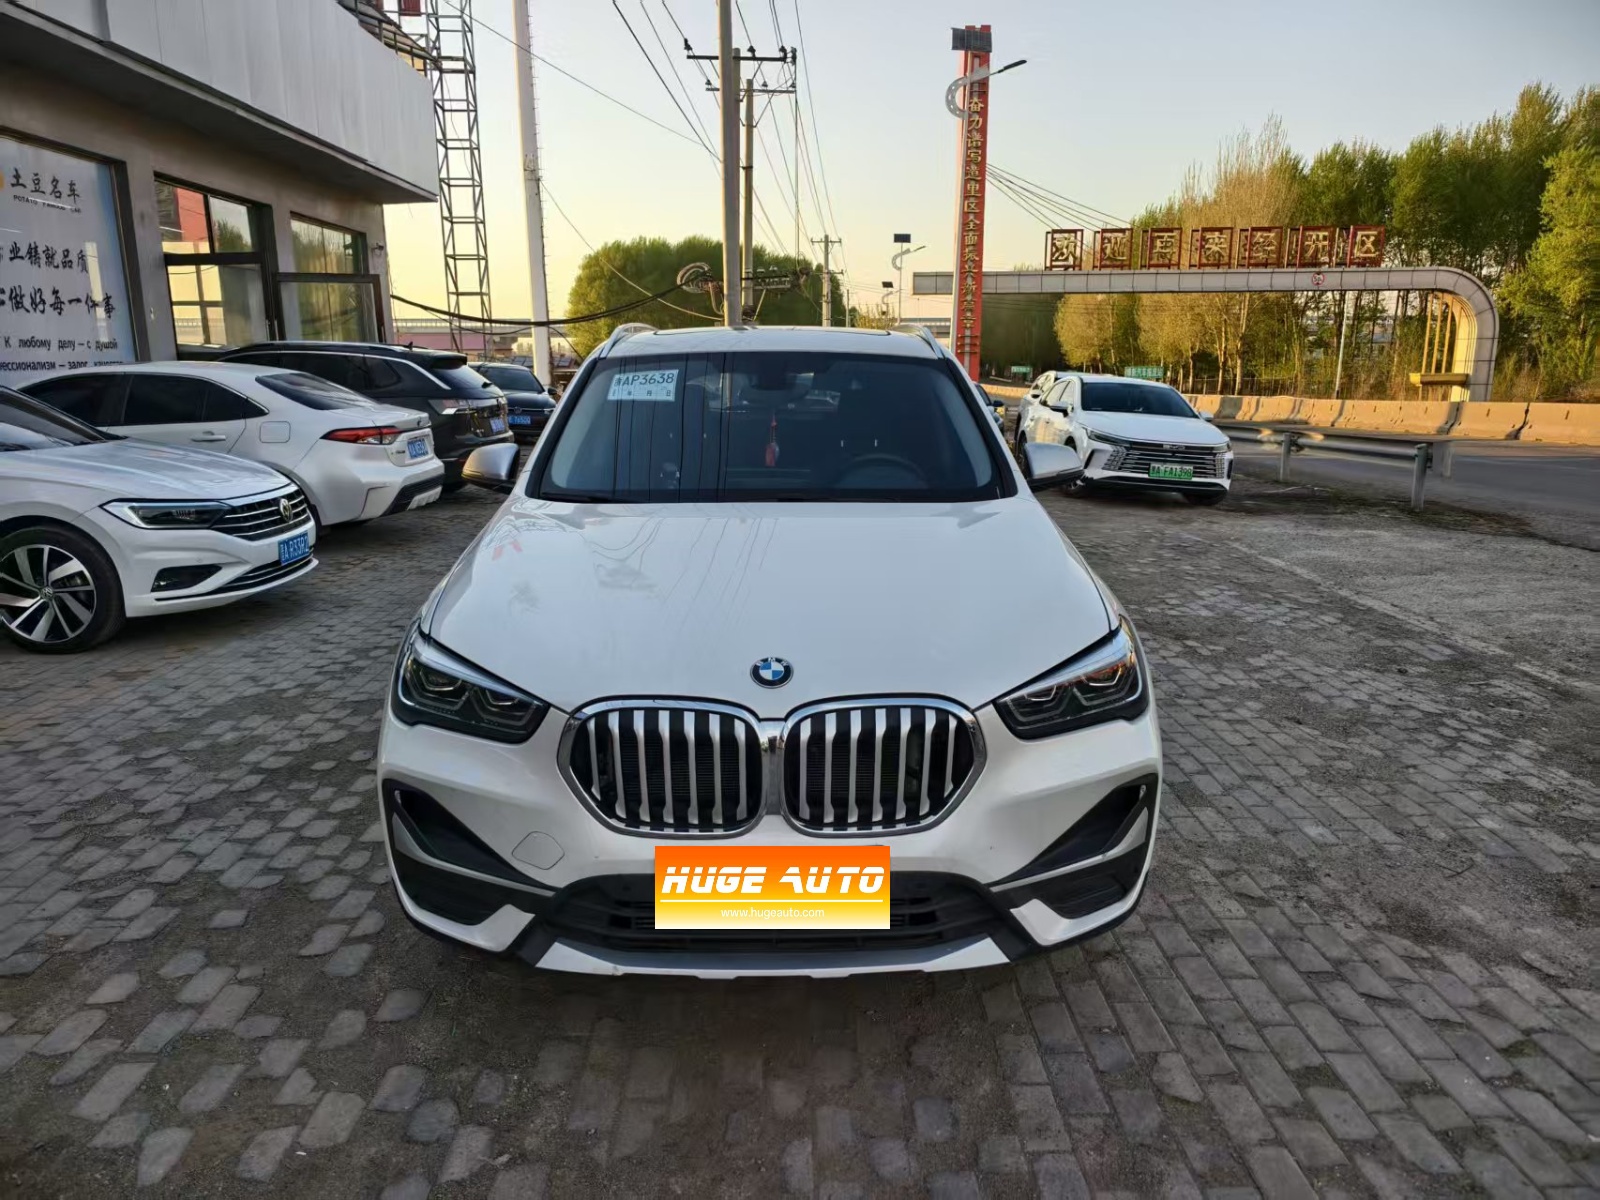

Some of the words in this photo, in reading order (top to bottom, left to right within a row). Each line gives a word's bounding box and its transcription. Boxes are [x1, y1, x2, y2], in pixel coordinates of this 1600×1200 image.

[10, 167, 80, 204] 土豆名车
[0, 241, 89, 274] 业铸就品质
[1052, 230, 1380, 262] 欢迎再来经开区
[4, 336, 12, 348] К
[18, 336, 51, 352] любому
[58, 339, 76, 352] делу
[0, 360, 56, 371] ессионализм
